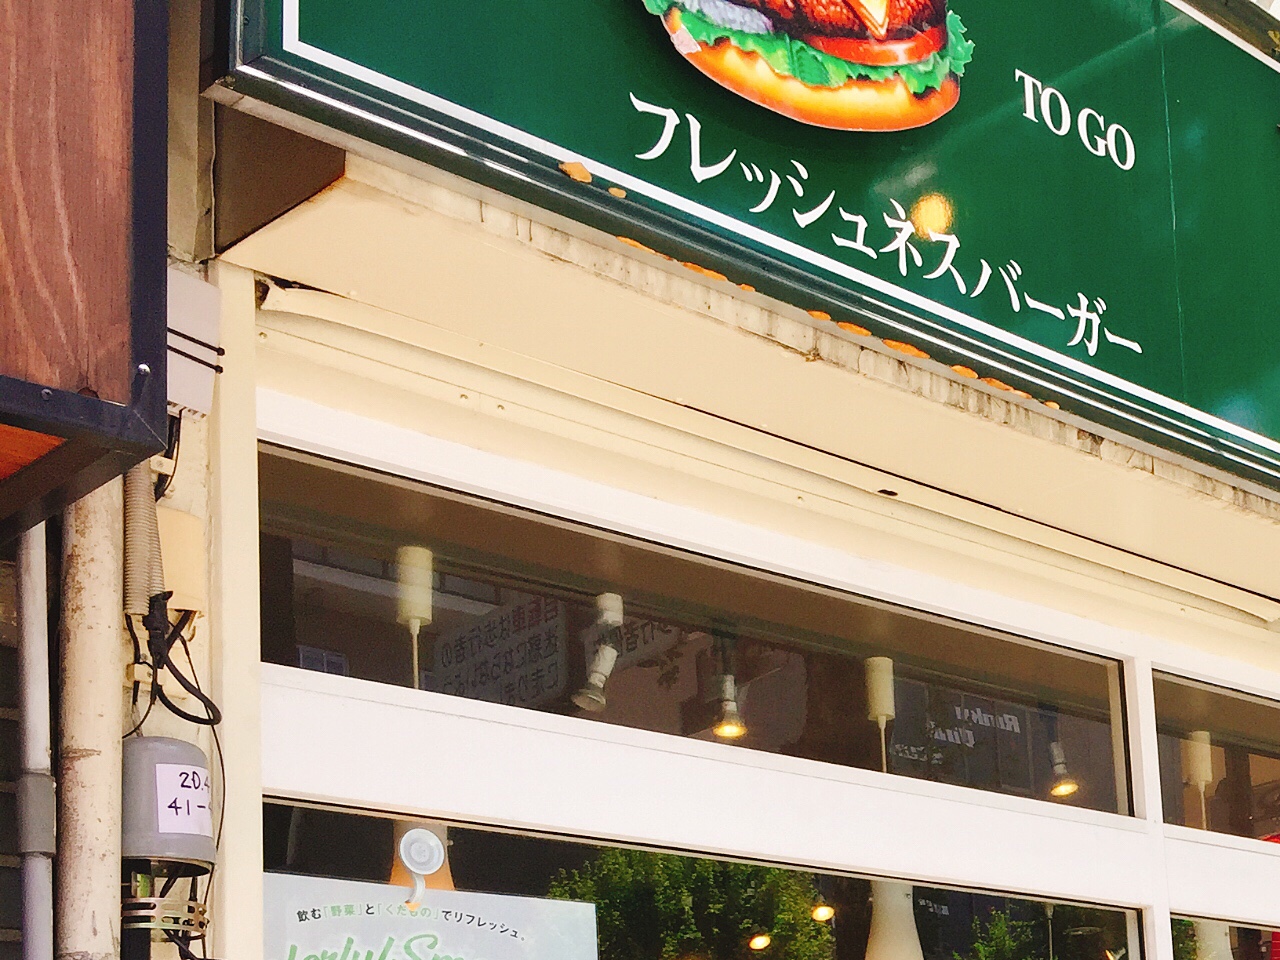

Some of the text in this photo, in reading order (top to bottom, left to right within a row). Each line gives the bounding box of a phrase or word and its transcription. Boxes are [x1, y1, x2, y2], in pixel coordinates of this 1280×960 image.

[1015, 69, 1135, 170] TO GO
[629, 92, 1143, 356] フレッシュネスバーガー
[167, 797, 213, 816] 41-
